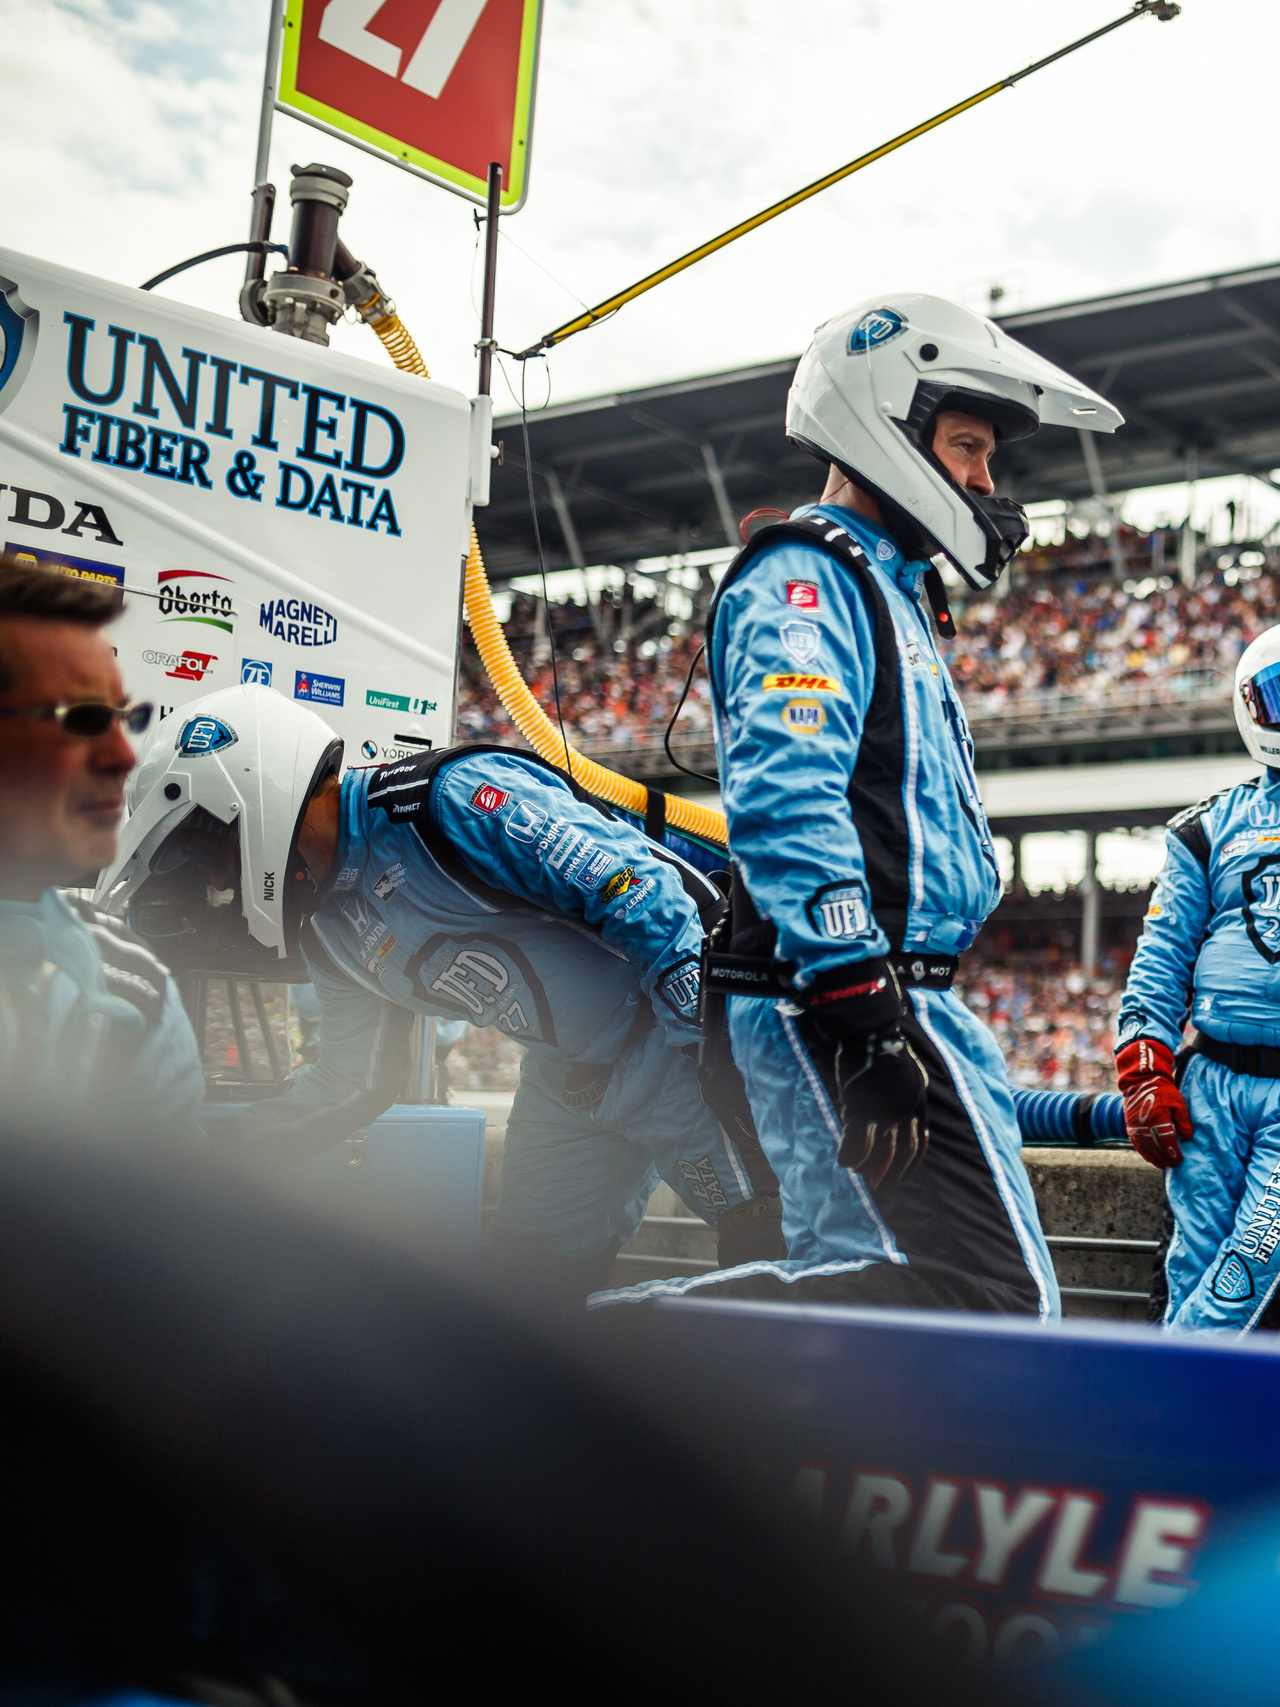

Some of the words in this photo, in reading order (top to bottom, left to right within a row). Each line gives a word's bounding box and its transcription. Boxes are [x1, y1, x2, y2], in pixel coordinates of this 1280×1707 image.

[63, 311, 406, 479] UNITED
[60, 403, 213, 490] FIBER
[226, 450, 264, 502] &
[276, 460, 402, 537] DATA
[0, 483, 124, 546] DA
[158, 585, 233, 617] Oberto
[259, 599, 338, 635] MAGNETI
[259, 611, 338, 647] MARELLI
[142, 649, 210, 674] ORAFOL
[245, 667, 269, 684] ZF
[775, 676, 832, 689] DHL
[368, 695, 400, 709] UniFirst
[187, 720, 217, 750] UFD
[552, 832, 577, 863] SIEMENS
[263, 870, 276, 902] NICK
[602, 866, 635, 903] SUNOCO
[359, 921, 388, 961] HNDA
[430, 949, 509, 1015] UFD
[710, 967, 769, 982] MOTOROLA
[498, 1000, 529, 1032] 27
[695, 1156, 729, 1207] DATA
[1217, 1260, 1244, 1295] UFD
[790, 1464, 1202, 1612] ARLYLE
